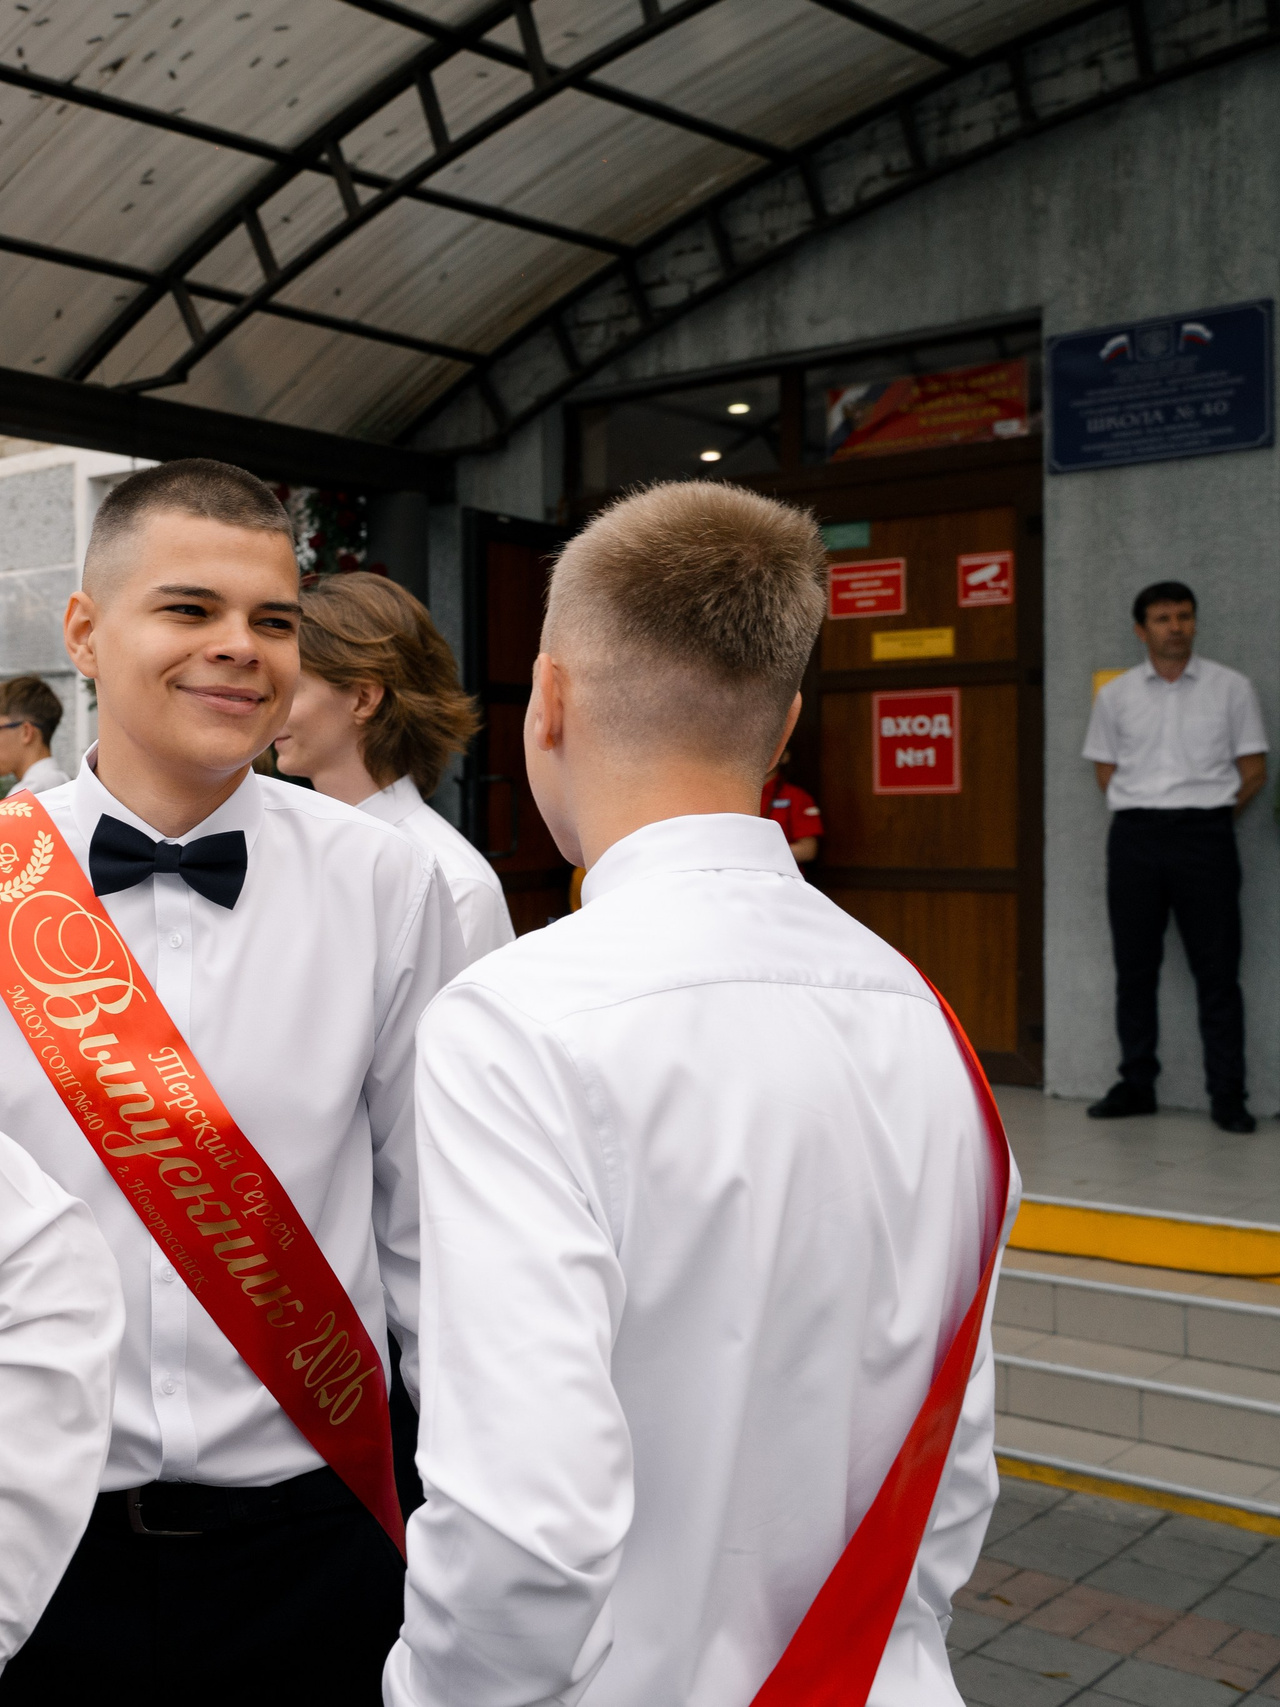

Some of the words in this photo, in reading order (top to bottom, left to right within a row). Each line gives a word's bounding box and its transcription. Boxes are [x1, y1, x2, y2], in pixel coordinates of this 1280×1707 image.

[1086, 409, 1165, 434] ШКОЛА
[1200, 401, 1230, 416] 40
[880, 714, 952, 738] ВХОД
[895, 747, 936, 768] №1
[6, 984, 55, 1041] МАОУ
[40, 1044, 82, 1092] СОШ
[68, 1089, 105, 1131] №40
[8, 890, 304, 1328] Выпускник
[285, 1310, 378, 1426] 2026
[147, 1046, 244, 1171] Терский
[230, 1171, 299, 1251] Сергей
[126, 1178, 209, 1294] Новороссийск
